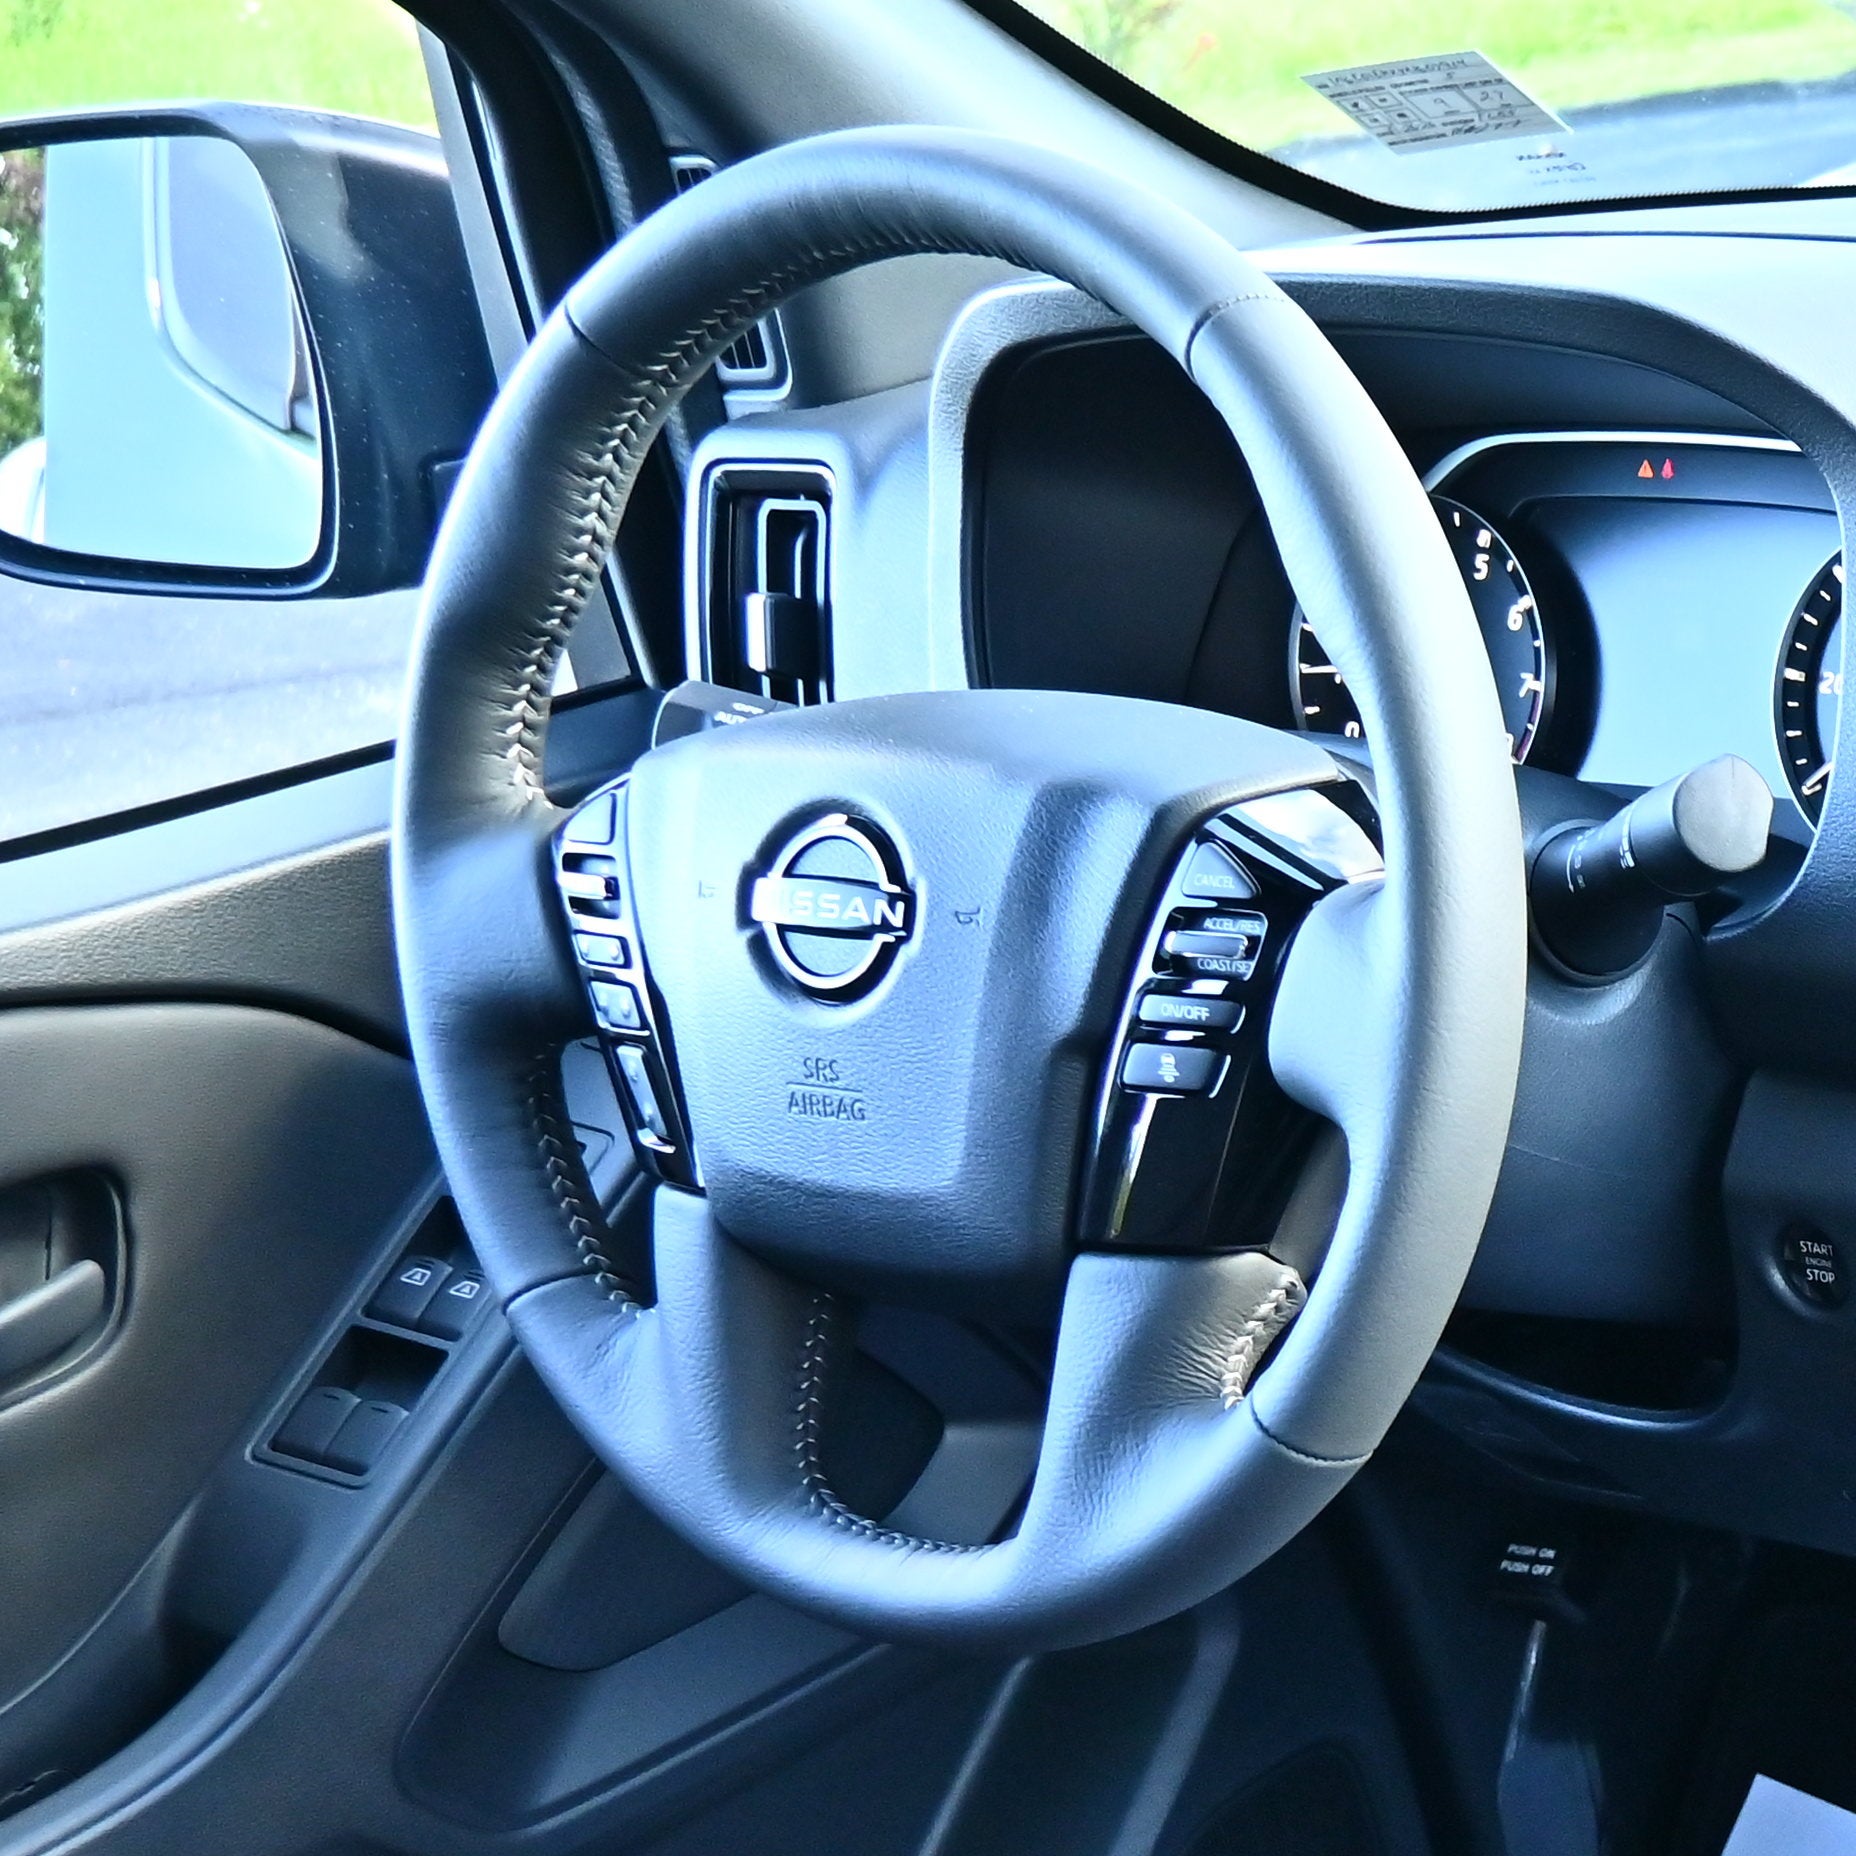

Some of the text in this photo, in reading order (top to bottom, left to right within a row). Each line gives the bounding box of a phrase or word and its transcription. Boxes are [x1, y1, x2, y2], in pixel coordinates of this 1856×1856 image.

[1473, 553, 1490, 581] 5
[1507, 604, 1524, 631] 6
[1519, 672, 1534, 698] 7
[1194, 873, 1236, 889] CANCEL
[762, 886, 906, 928] SSAN
[1160, 1003, 1211, 1021] ON/OFF
[803, 1056, 840, 1082] SRS
[787, 1090, 866, 1121] AIRBAG
[1800, 1240, 1833, 1257] START
[1806, 1269, 1836, 1284] STOP
